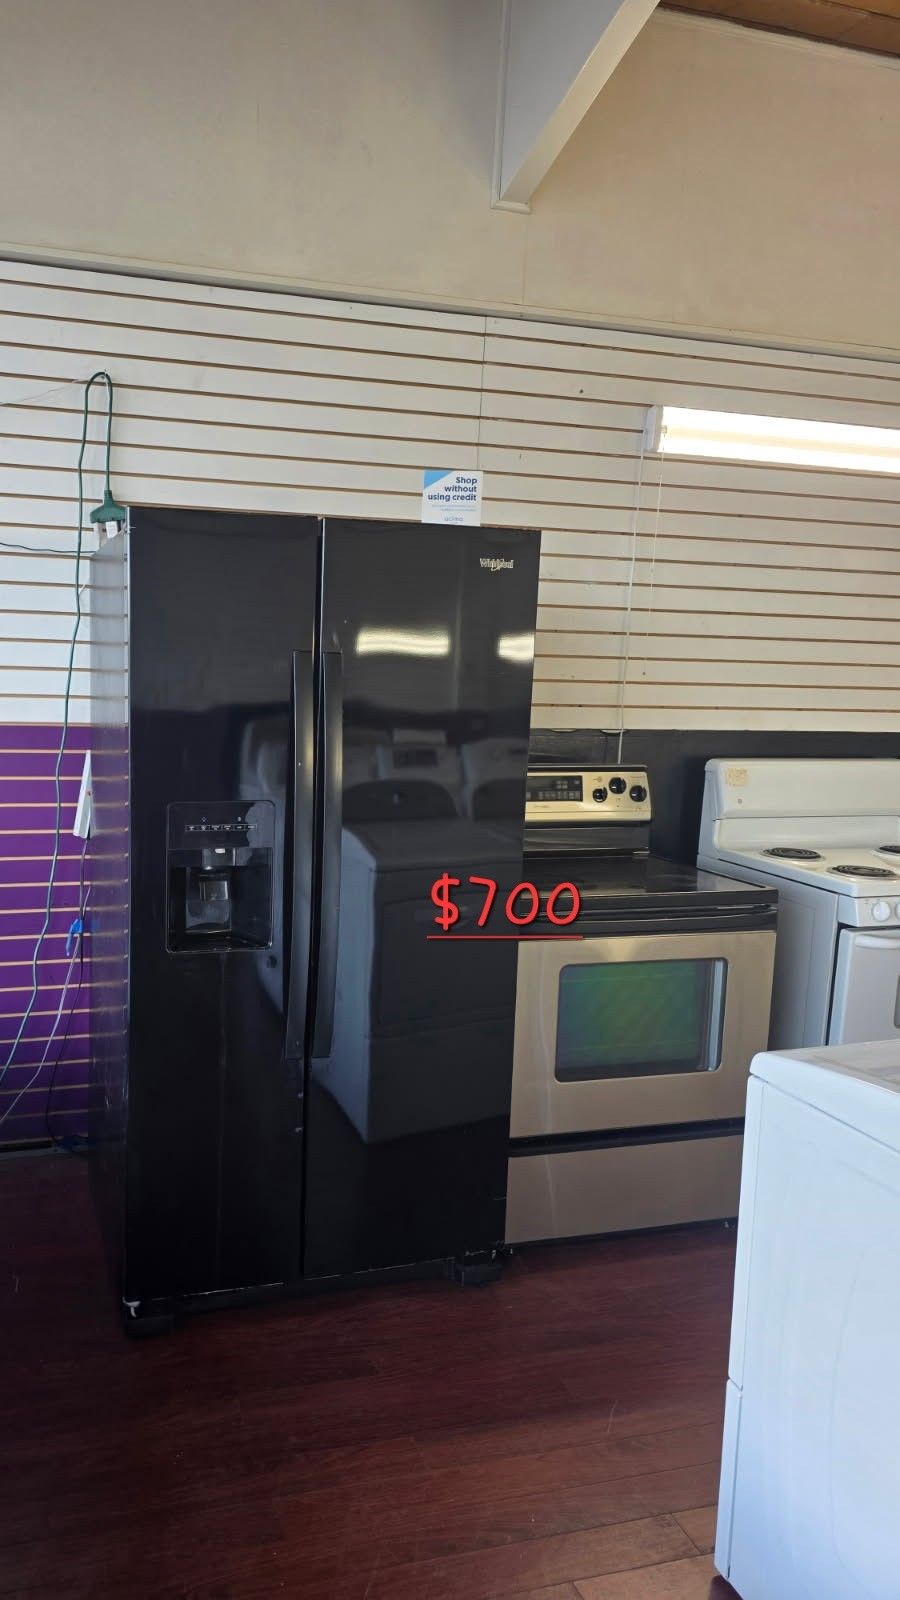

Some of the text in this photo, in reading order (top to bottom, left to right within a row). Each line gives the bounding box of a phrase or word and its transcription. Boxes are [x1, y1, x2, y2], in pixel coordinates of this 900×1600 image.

[456, 476, 477, 485] Shop
[428, 493, 477, 502] using credit
